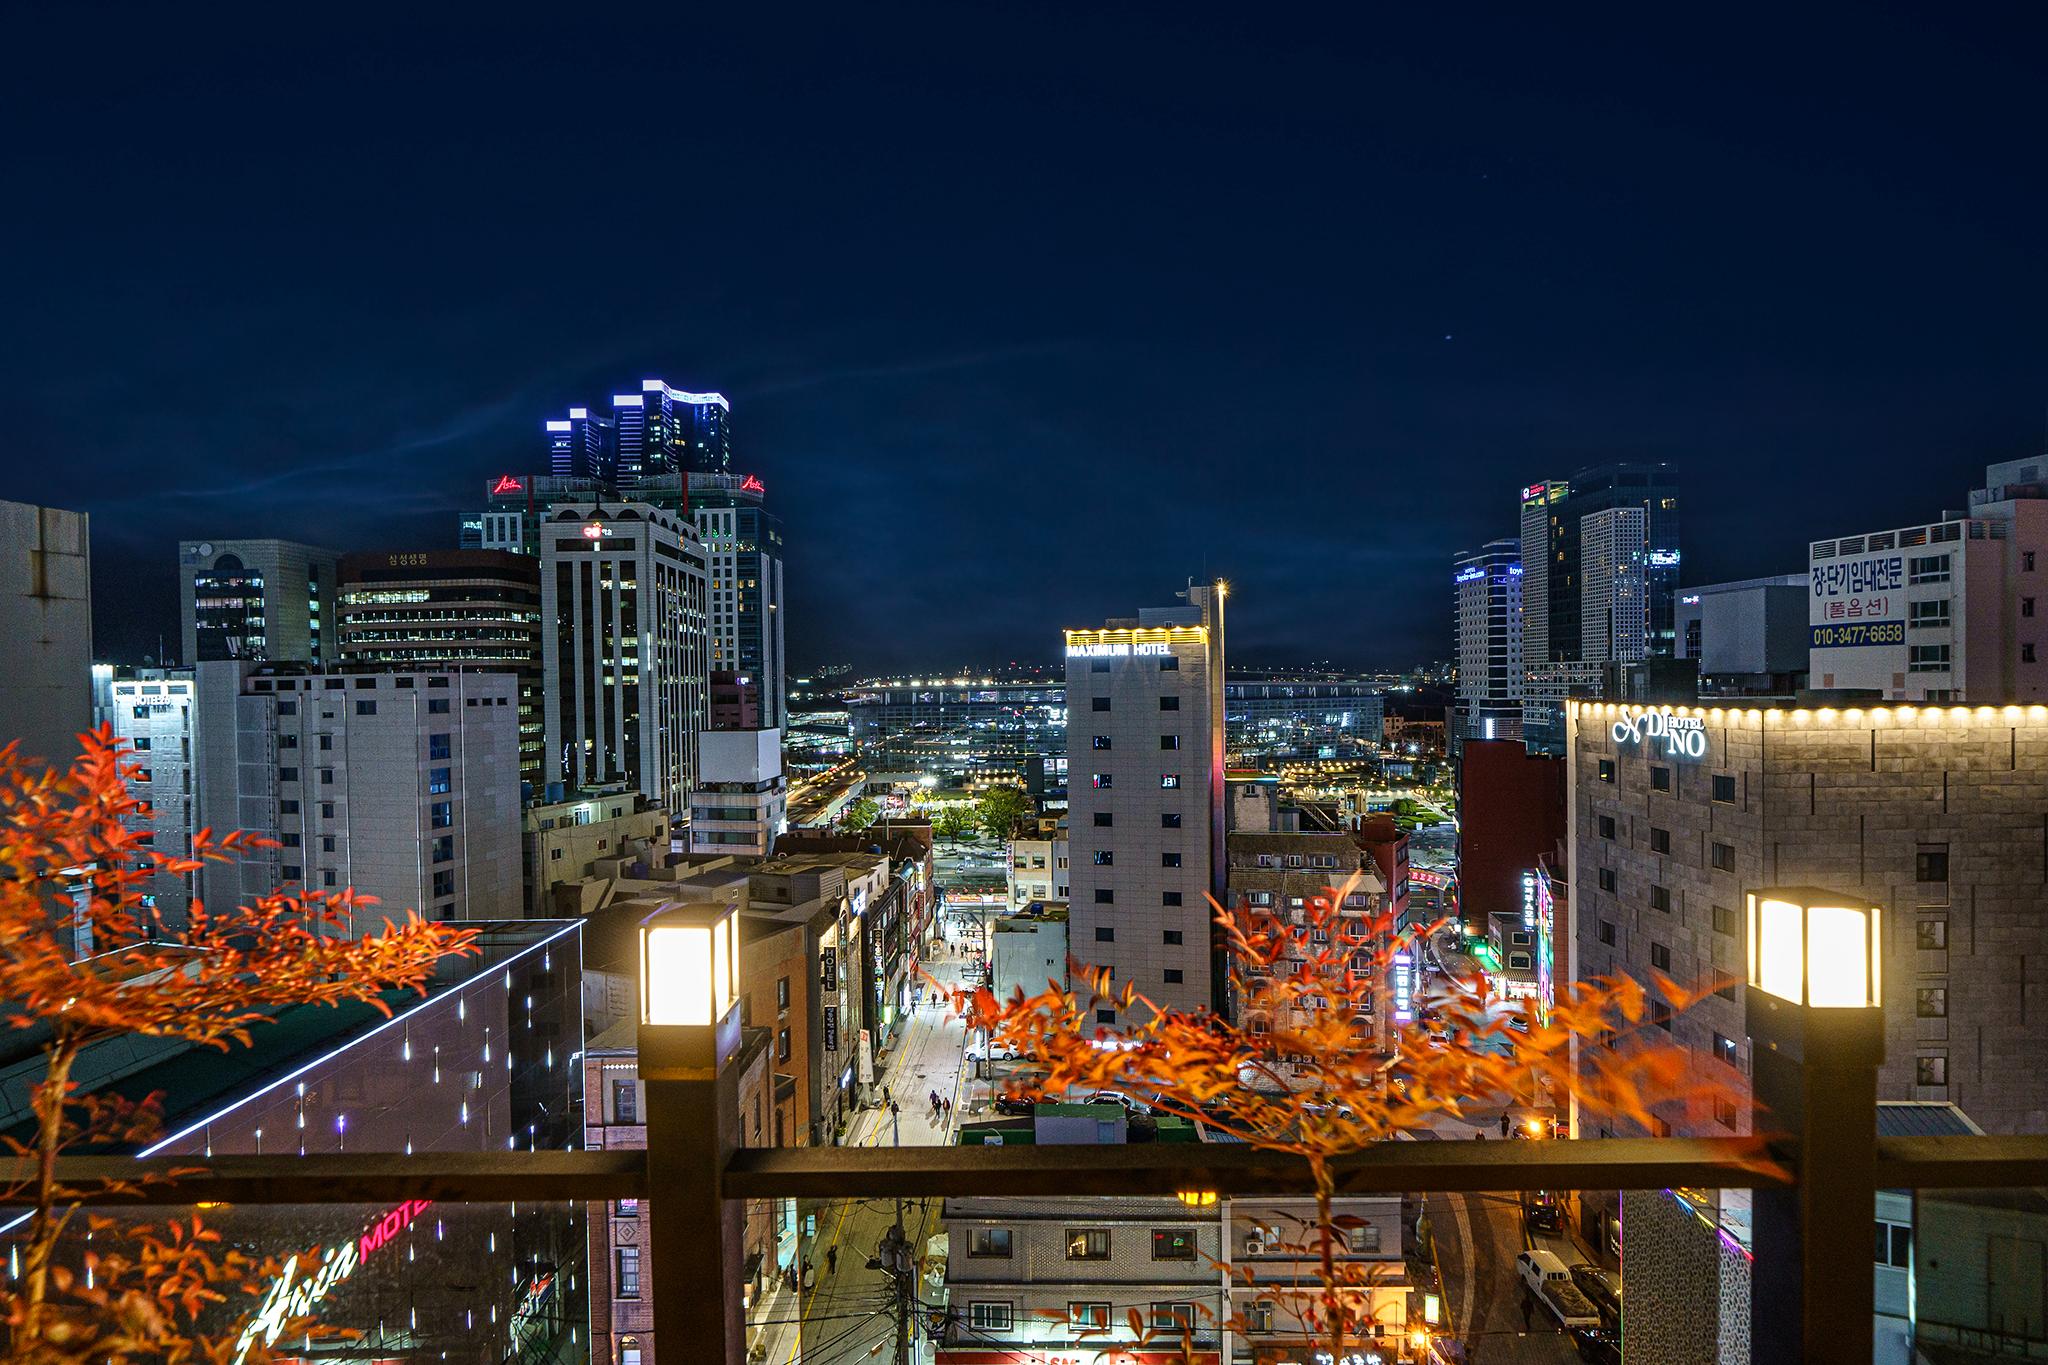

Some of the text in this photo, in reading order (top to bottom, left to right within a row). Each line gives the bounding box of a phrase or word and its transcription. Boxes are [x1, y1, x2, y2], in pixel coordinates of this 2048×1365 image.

[389, 553, 428, 566] 삼성생명
[1813, 624, 1902, 645] 010-3477-6658
[1066, 643, 1171, 657] MAXIMUM HOTEL
[1668, 716, 1705, 730] HOTEL
[826, 949, 834, 990] HOTEL
[360, 1199, 432, 1265] MOTE
